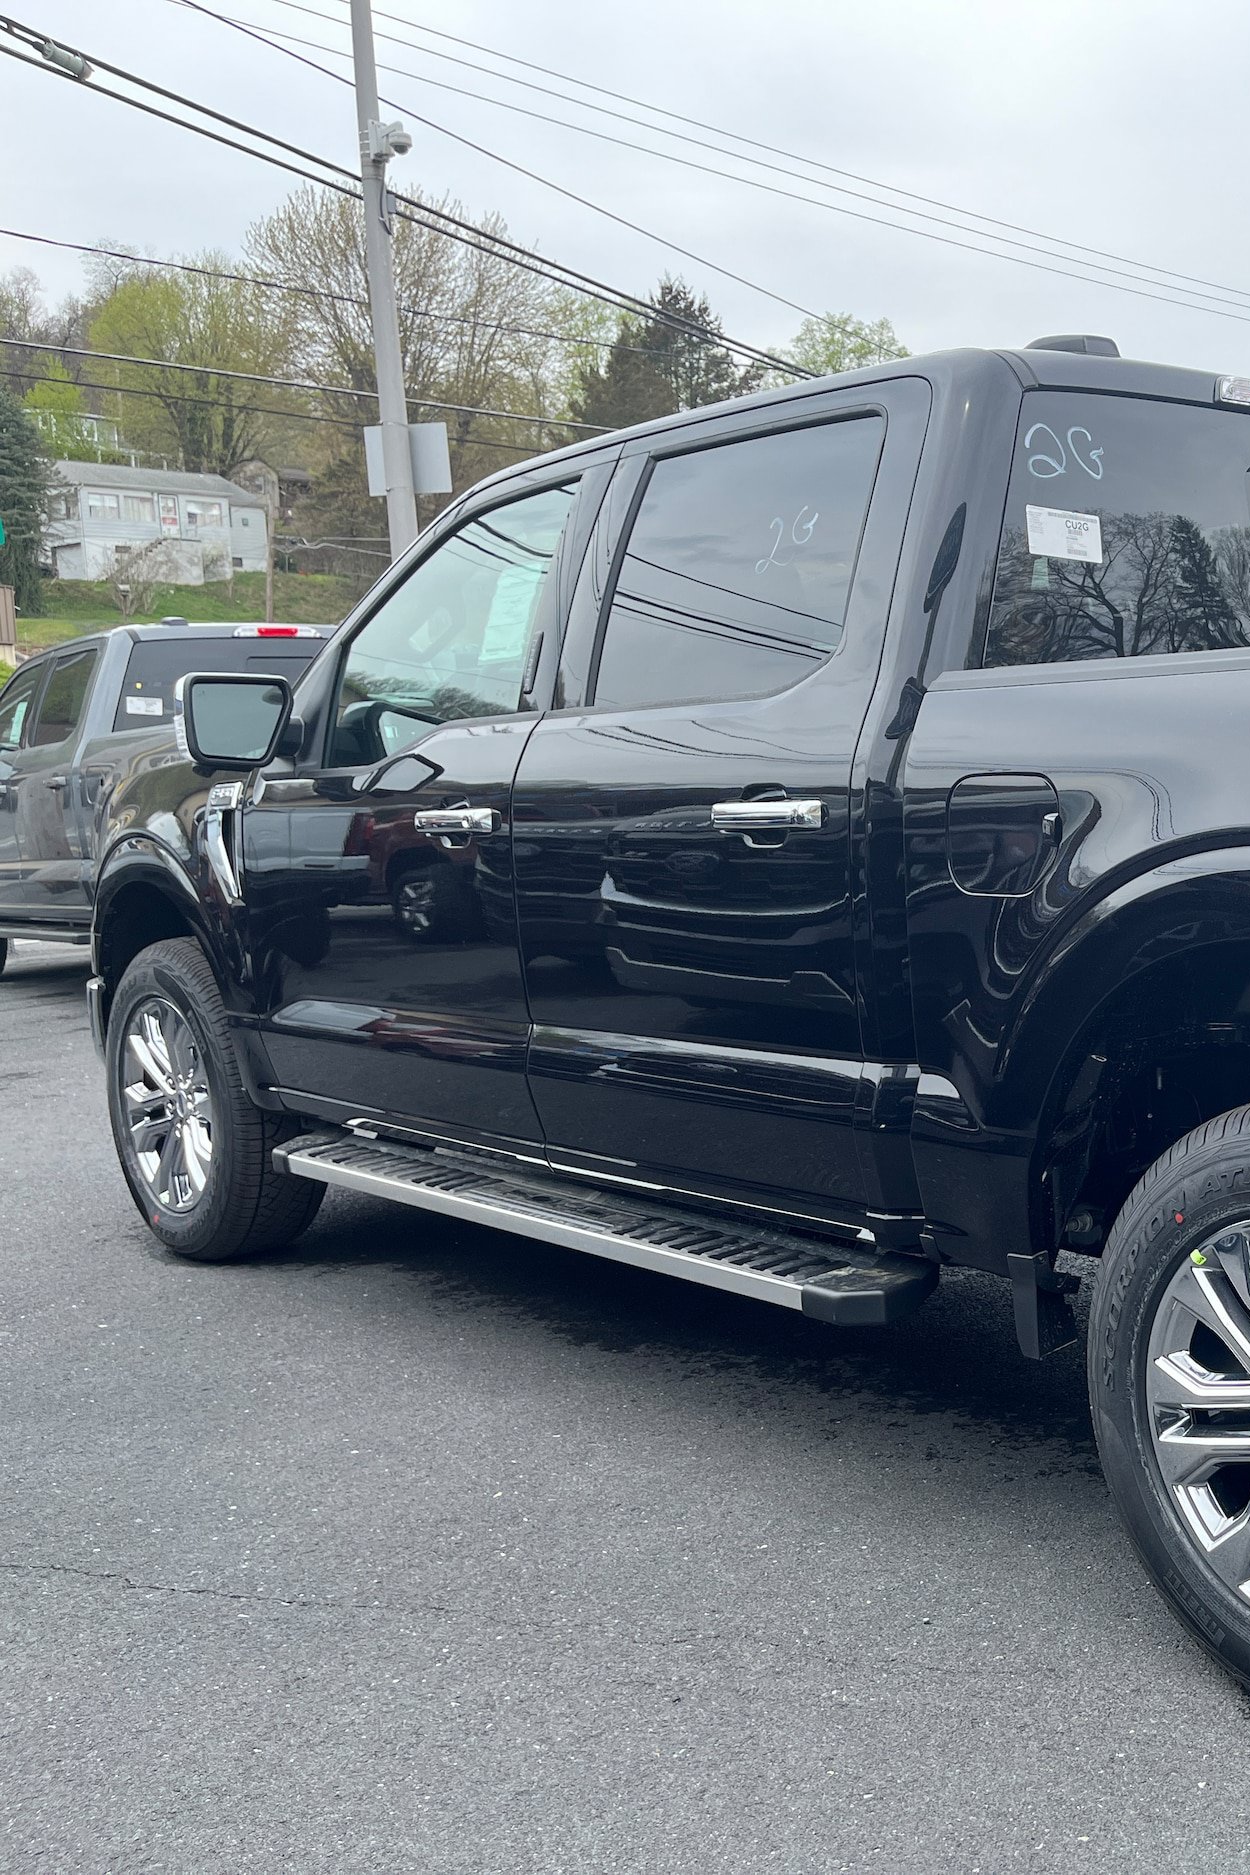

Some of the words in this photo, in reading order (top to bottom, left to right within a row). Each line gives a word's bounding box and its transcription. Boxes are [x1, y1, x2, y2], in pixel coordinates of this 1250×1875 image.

[1024, 422, 1104, 480] 2G
[754, 505, 819, 574] 2G
[1065, 520, 1089, 531] CU2G
[1103, 1190, 1187, 1392] SCORPION
